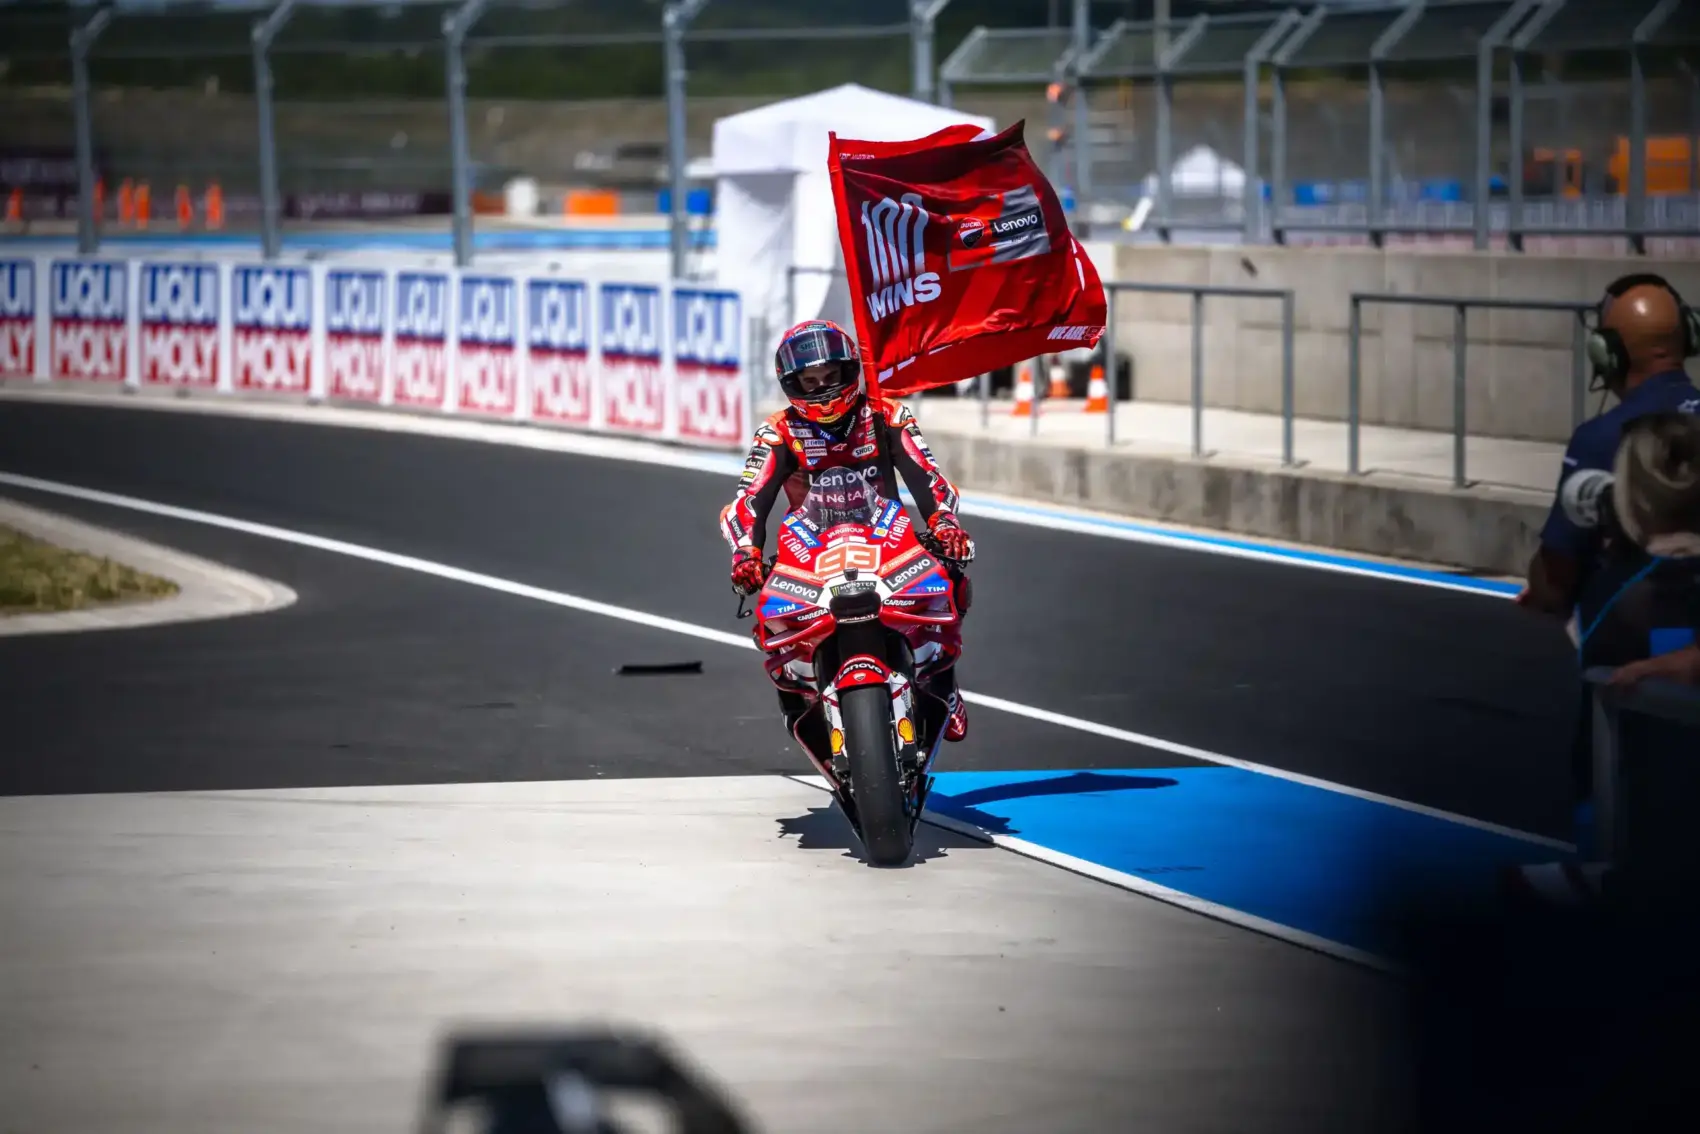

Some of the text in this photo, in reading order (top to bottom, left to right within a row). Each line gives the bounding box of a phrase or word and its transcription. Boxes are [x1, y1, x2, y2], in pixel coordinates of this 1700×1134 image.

[993, 214, 1037, 233] Lenovo
[53, 264, 125, 318] LIQUI
[144, 269, 217, 321] LIQUI
[236, 272, 308, 327] LIQUI
[866, 272, 941, 322] WINS
[54, 321, 127, 376] MOLY
[145, 325, 217, 381] MOLY
[237, 330, 309, 386] MOLY
[820, 429, 832, 440] TIM
[844, 415, 856, 437] Lenovo
[856, 446, 873, 456] SHOEI
[809, 466, 877, 487] Lenovo
[731, 516, 742, 537] Lenovo
[889, 516, 911, 541] riello
[784, 537, 811, 563] riello
[817, 543, 879, 579] 93
[886, 558, 931, 588] Lenovo
[771, 576, 818, 598] Lenovo
[777, 603, 796, 613] TIM
[797, 609, 828, 621] CARRERA
[838, 662, 883, 680] Lenovo
